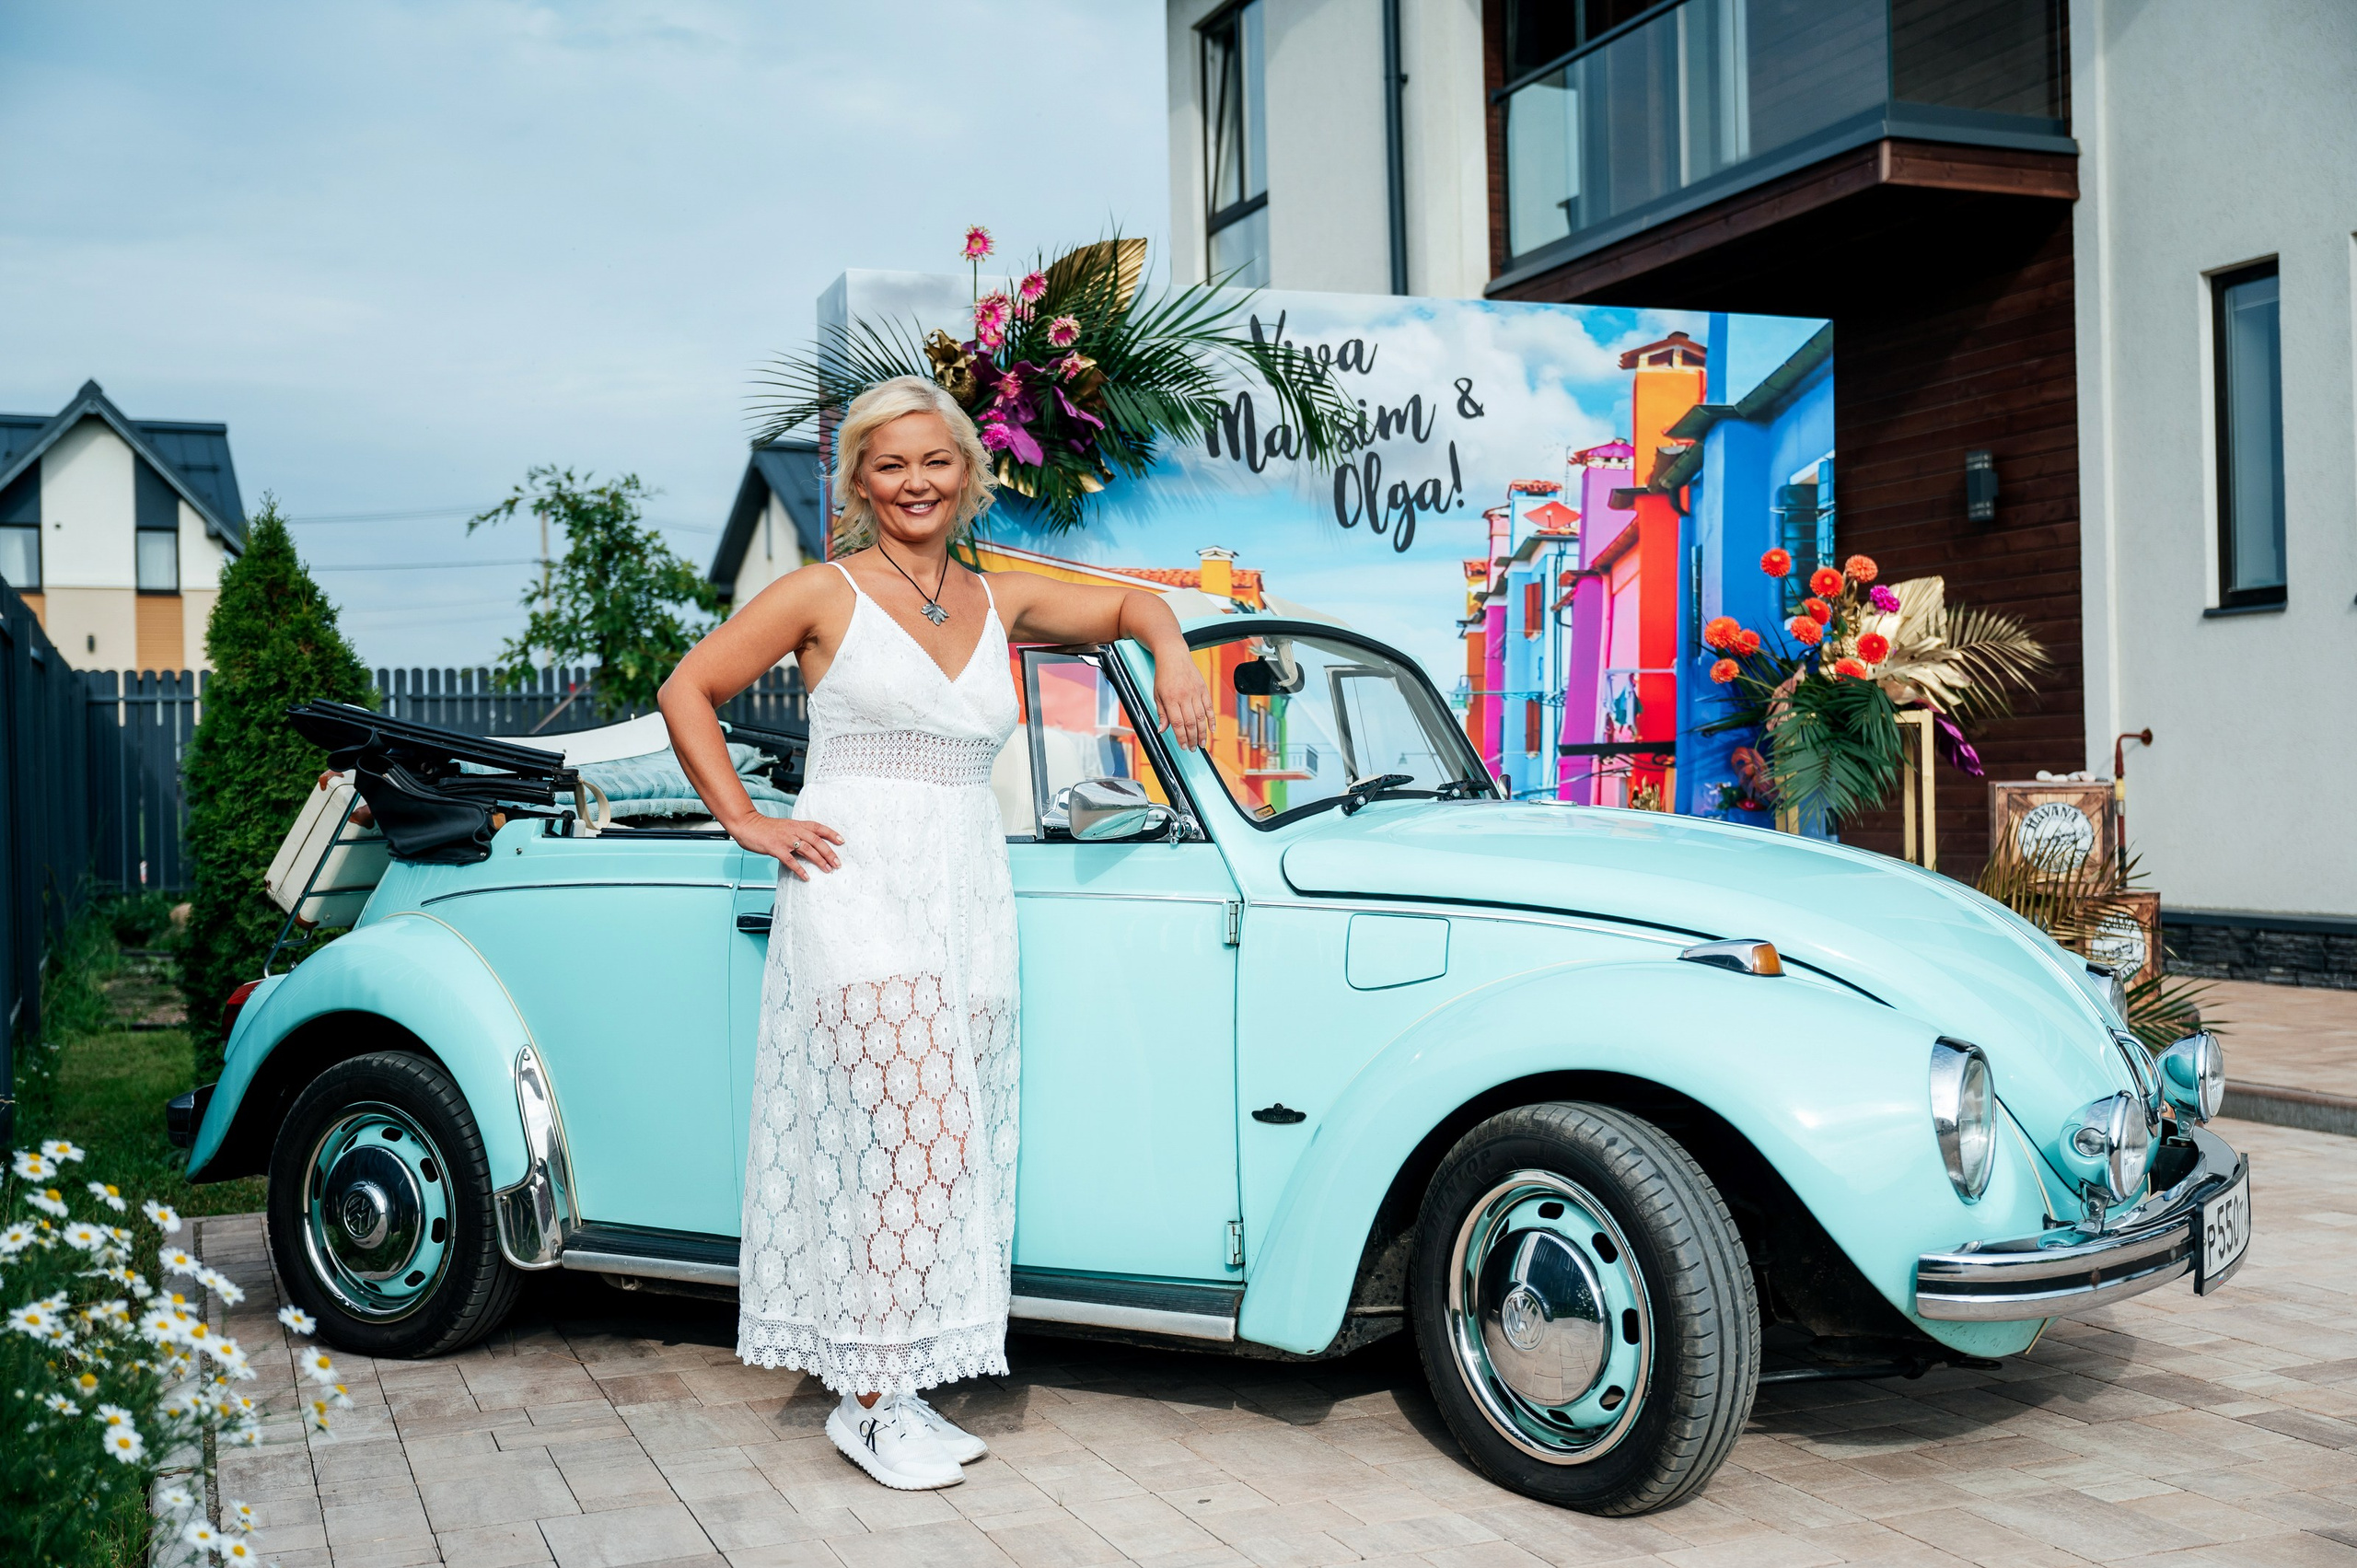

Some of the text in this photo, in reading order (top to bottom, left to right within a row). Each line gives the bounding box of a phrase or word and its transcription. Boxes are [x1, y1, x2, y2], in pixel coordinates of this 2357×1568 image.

[1249, 309, 1377, 387] Viva
[1454, 377, 1485, 419] &
[1335, 440, 1464, 552] Olga!
[2025, 806, 2078, 830] HAVANA
